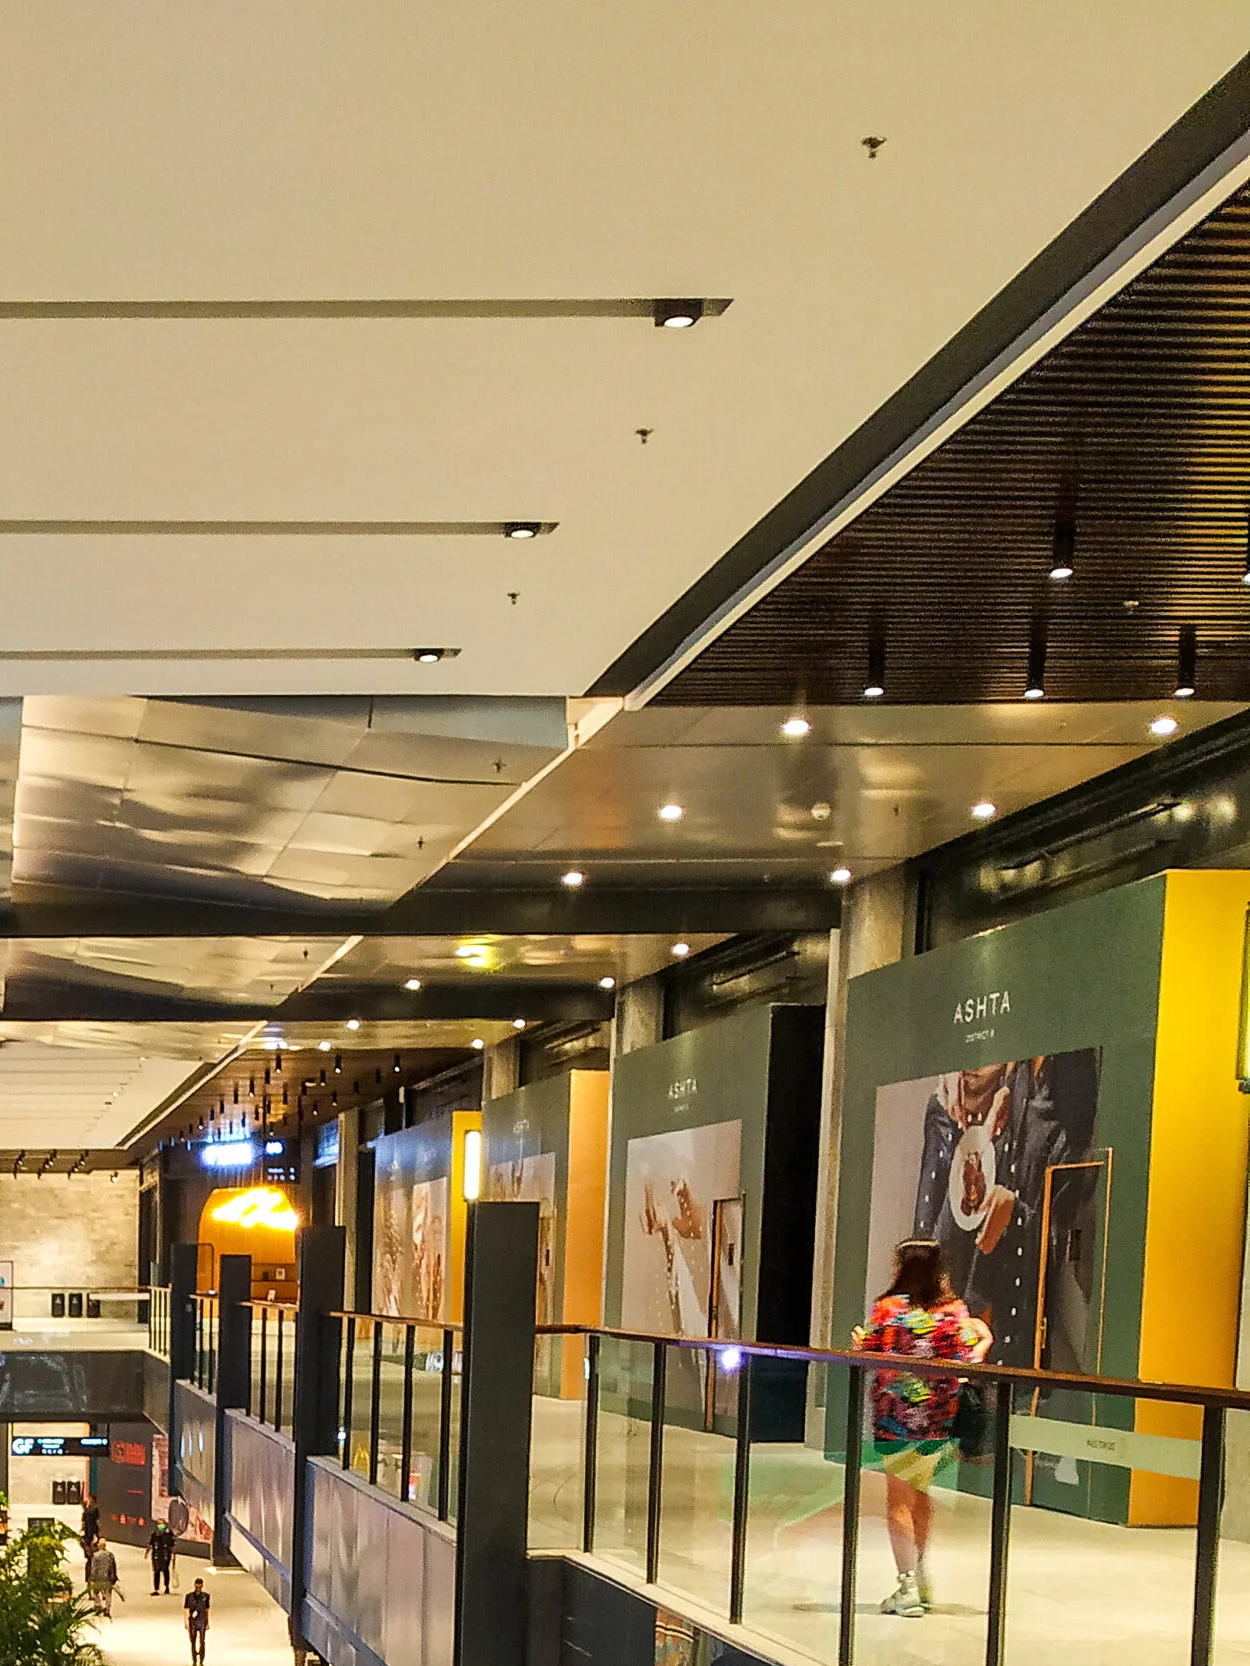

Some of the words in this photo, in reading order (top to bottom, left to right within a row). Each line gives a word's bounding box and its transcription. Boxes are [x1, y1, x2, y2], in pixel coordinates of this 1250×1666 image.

[953, 990, 1010, 1024] ASHTA
[668, 1079, 698, 1099] ASHTA
[12, 1438, 35, 1454] GF
